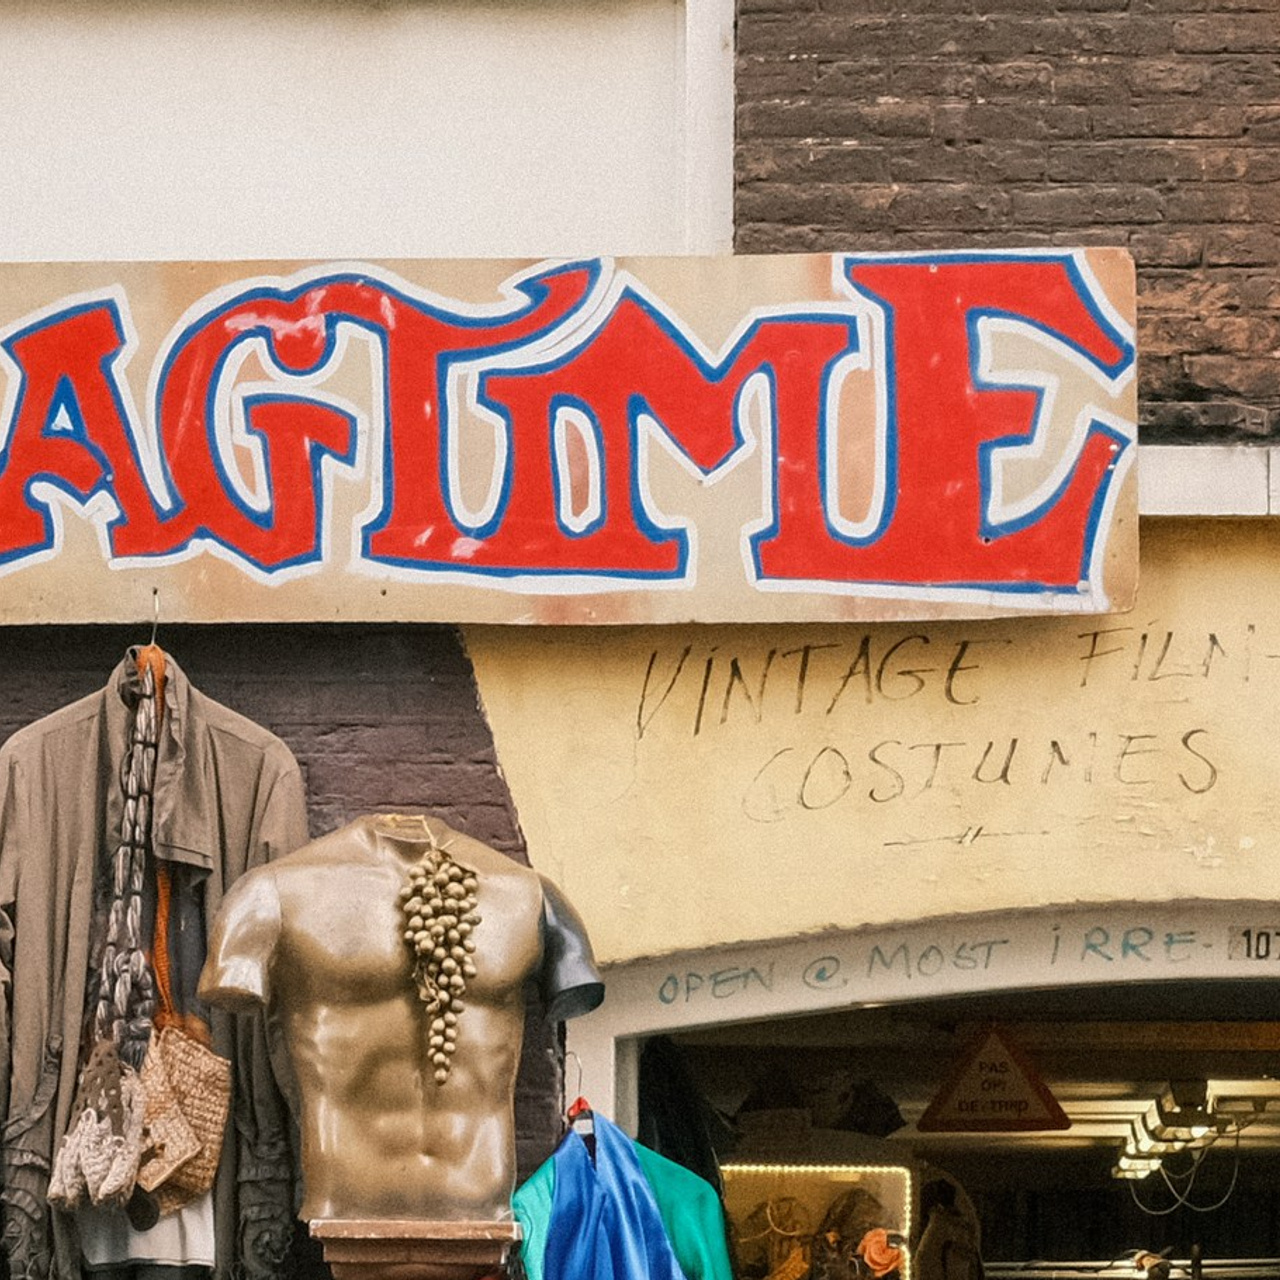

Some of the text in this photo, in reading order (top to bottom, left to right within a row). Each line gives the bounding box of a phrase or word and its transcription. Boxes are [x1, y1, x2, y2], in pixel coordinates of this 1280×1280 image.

[743, 728, 1218, 823] COSTUMES
[658, 961, 776, 1004] OPEN
[866, 939, 1010, 979] MOST
